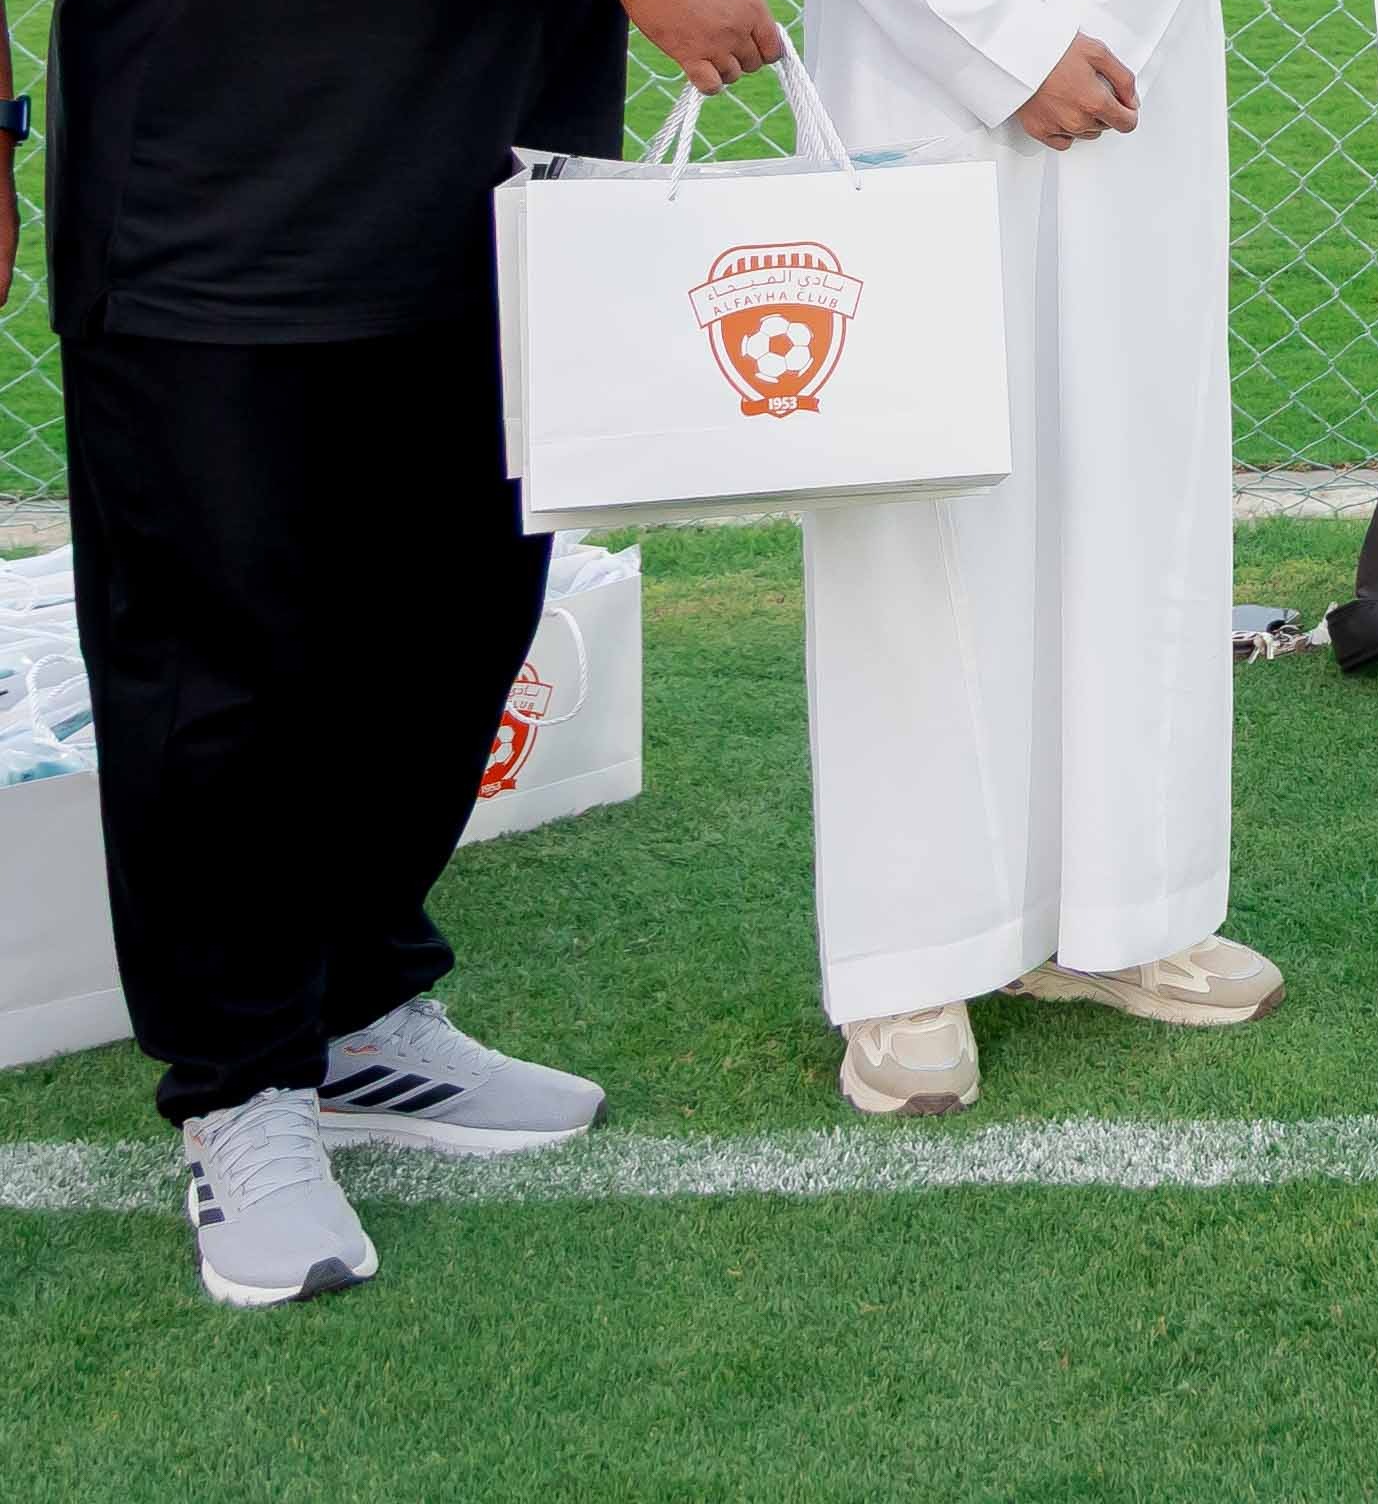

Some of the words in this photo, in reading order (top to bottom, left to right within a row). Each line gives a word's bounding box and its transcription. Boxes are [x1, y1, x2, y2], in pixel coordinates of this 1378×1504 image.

[713, 290, 789, 317] ALFAYHA
[796, 291, 839, 309] CLUB
[768, 397, 798, 410] 1953
[508, 699, 536, 710] LUB
